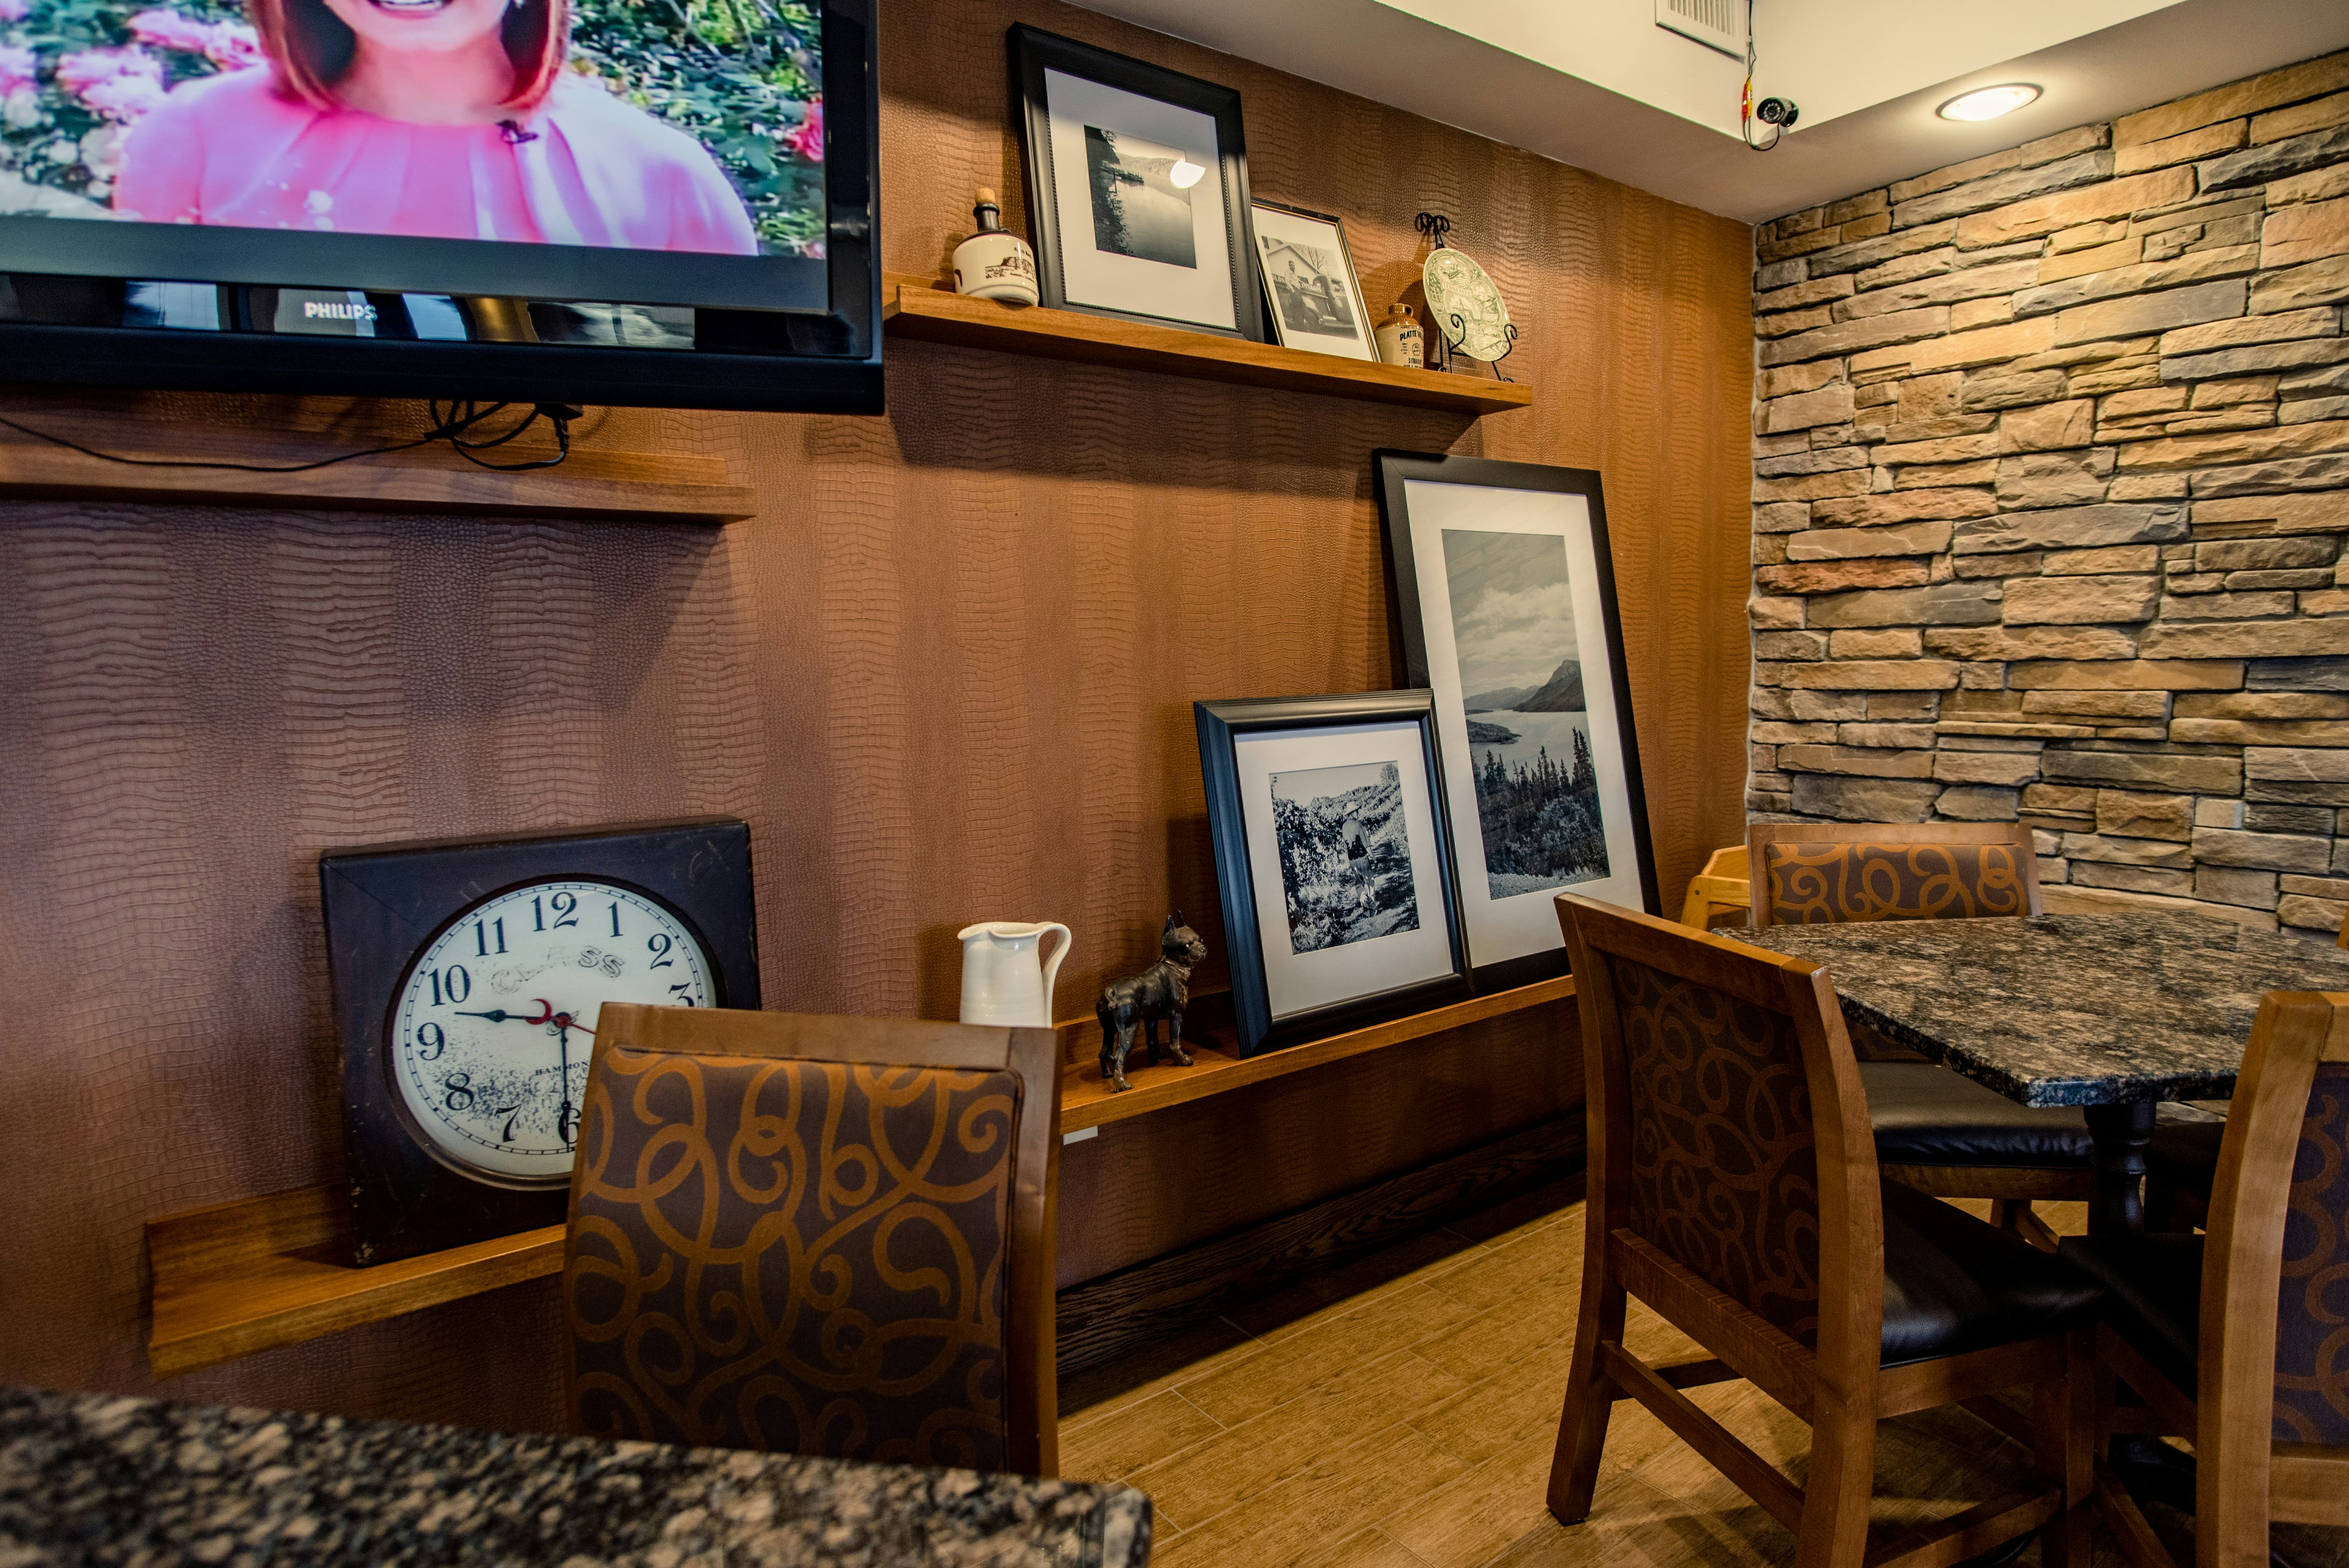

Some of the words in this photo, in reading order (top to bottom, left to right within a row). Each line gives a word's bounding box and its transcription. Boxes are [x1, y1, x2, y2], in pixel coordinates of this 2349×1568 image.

[304, 302, 377, 321] PHILIPS
[1400, 330, 1417, 341] PLATTE
[531, 891, 579, 932] 12
[608, 901, 624, 937] 1
[473, 916, 510, 957] 11
[648, 933, 674, 970] 2
[428, 964, 471, 1007] 10
[668, 981, 694, 1007] 3
[417, 1022, 445, 1060] 9
[445, 1072, 474, 1111] 8
[495, 1103, 522, 1142] 7
[558, 1107, 582, 1144] 6
